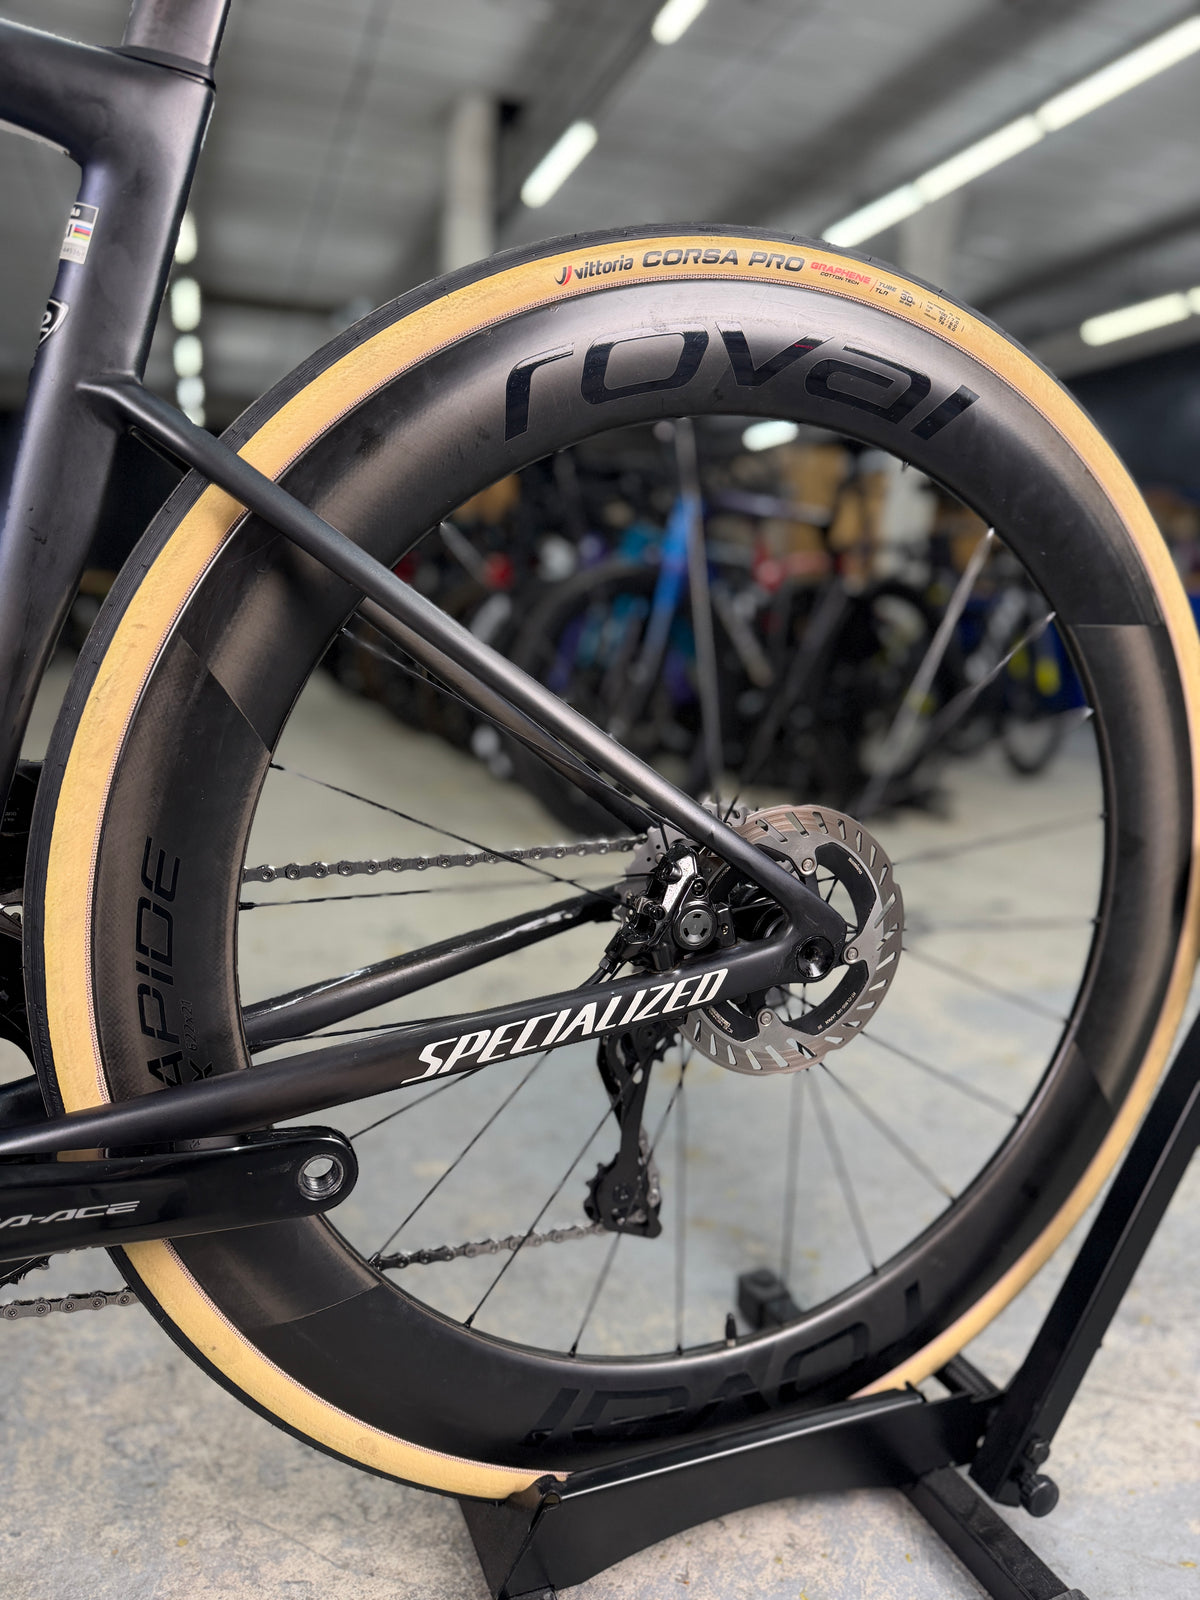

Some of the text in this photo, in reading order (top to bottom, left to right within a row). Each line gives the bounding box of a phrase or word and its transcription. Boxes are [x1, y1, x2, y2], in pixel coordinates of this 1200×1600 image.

[574, 248, 806, 280] vittoria CORSA PRO
[810, 261, 871, 284] GRAPHENE
[820, 271, 860, 286] COTTON TECH
[504, 321, 981, 442] roval
[400, 968, 728, 1084] SPECIALIZED
